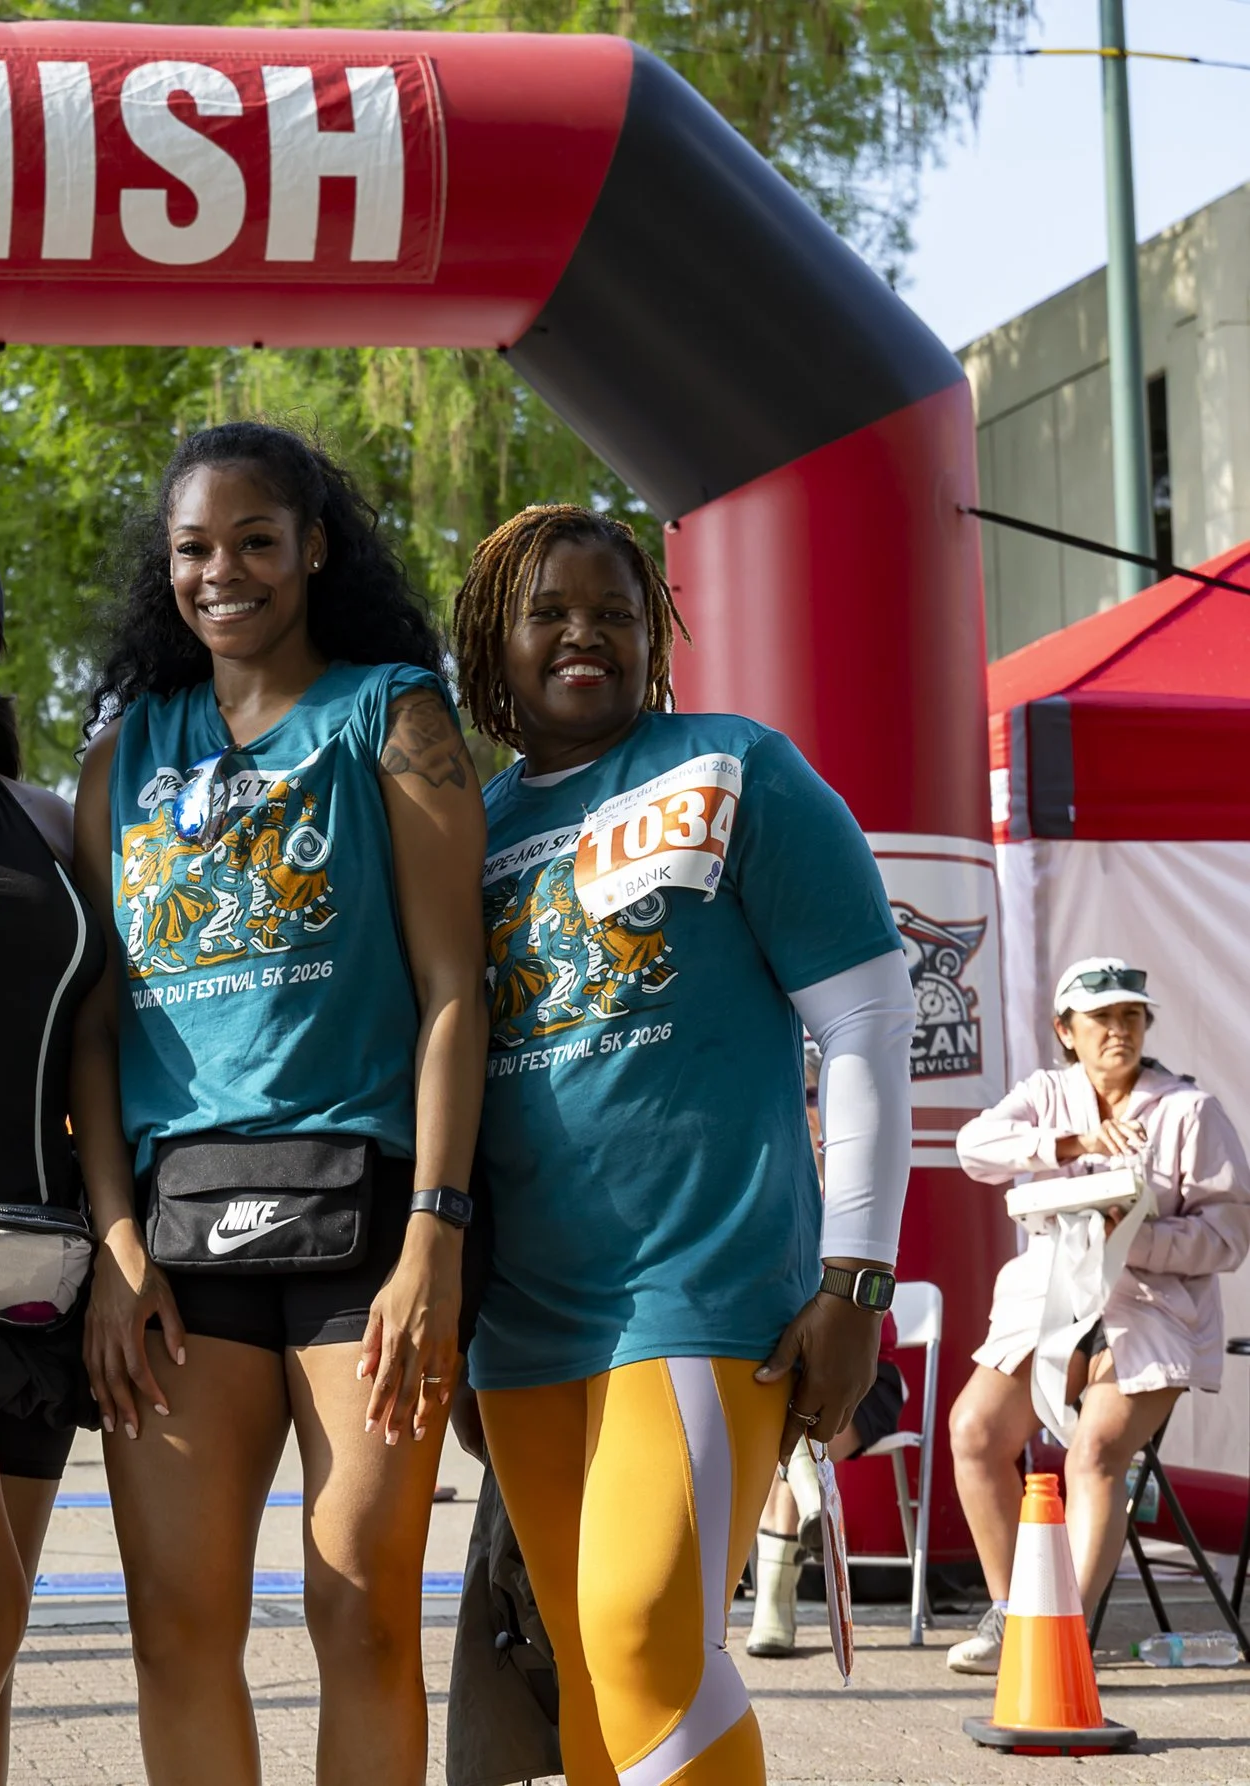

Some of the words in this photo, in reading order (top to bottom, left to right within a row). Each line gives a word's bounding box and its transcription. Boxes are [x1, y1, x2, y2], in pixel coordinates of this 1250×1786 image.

[596, 794, 635, 818] Courir
[637, 786, 652, 798] du
[655, 762, 707, 790] Festival
[712, 760, 738, 778] 2026
[549, 834, 569, 851] SI
[588, 790, 735, 878] 1034
[132, 987, 163, 1010] OURIR
[166, 984, 184, 1004] DU
[187, 971, 256, 1001] FESTIVAL
[262, 966, 287, 987] 5K
[289, 960, 333, 984] 2026
[501, 1056, 516, 1076] DU
[519, 1038, 594, 1073] FESTIVAL
[600, 1031, 624, 1053] 5K
[627, 1022, 673, 1048] 2026
[910, 1057, 970, 1074] RVICES
[218, 1200, 280, 1231] NIKE
